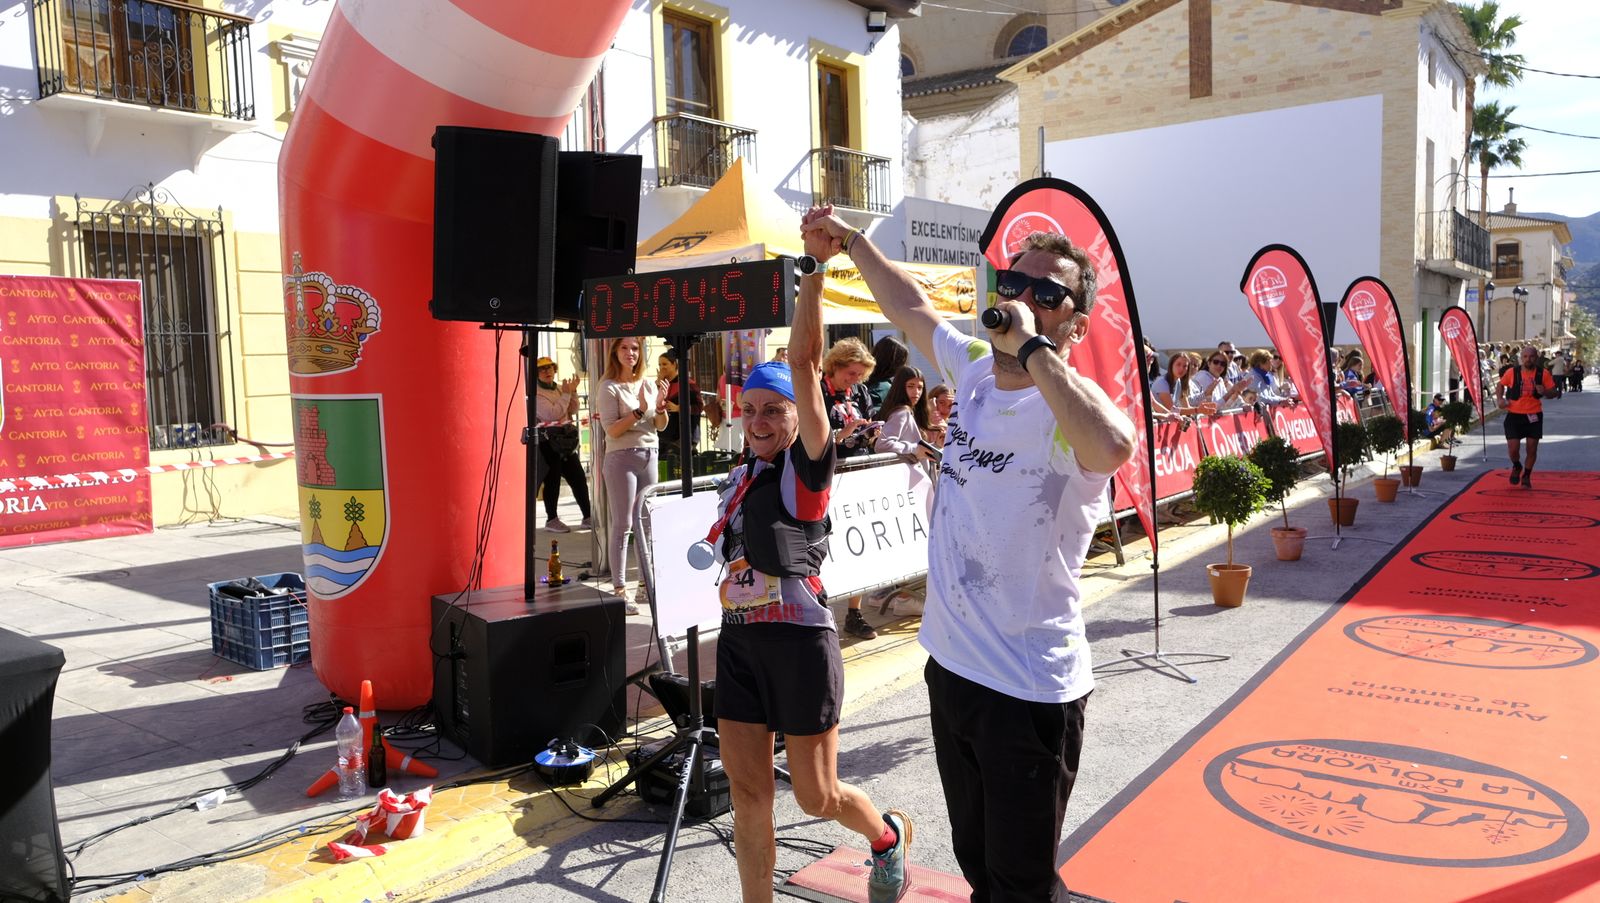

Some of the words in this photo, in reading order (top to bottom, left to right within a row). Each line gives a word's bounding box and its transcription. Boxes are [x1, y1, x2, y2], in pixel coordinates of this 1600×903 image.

[911, 220, 981, 244] EXCELENTÍSIMO
[912, 245, 981, 267] AYUNTAMIENTO
[0, 287, 59, 299] CANTORIA
[2, 335, 62, 346] CANTORIA
[65, 360, 120, 371] CANTORIA
[6, 382, 65, 393] CANTORIA
[69, 406, 123, 417] CANTORIA
[8, 429, 68, 441] CANTORIA
[71, 450, 126, 463] CANTORIA
[1153, 442, 1197, 477] EOLIA
[74, 495, 128, 508] CANTORIA
[898, 490, 917, 508] DE
[826, 512, 929, 563] ORIA
[1351, 680, 1480, 704] Cantoria
[1327, 686, 1549, 722] Ayuntamiento
[1491, 700, 1531, 709] de
[1296, 743, 1392, 766] Cantoria
[1481, 781, 1537, 801] LA
